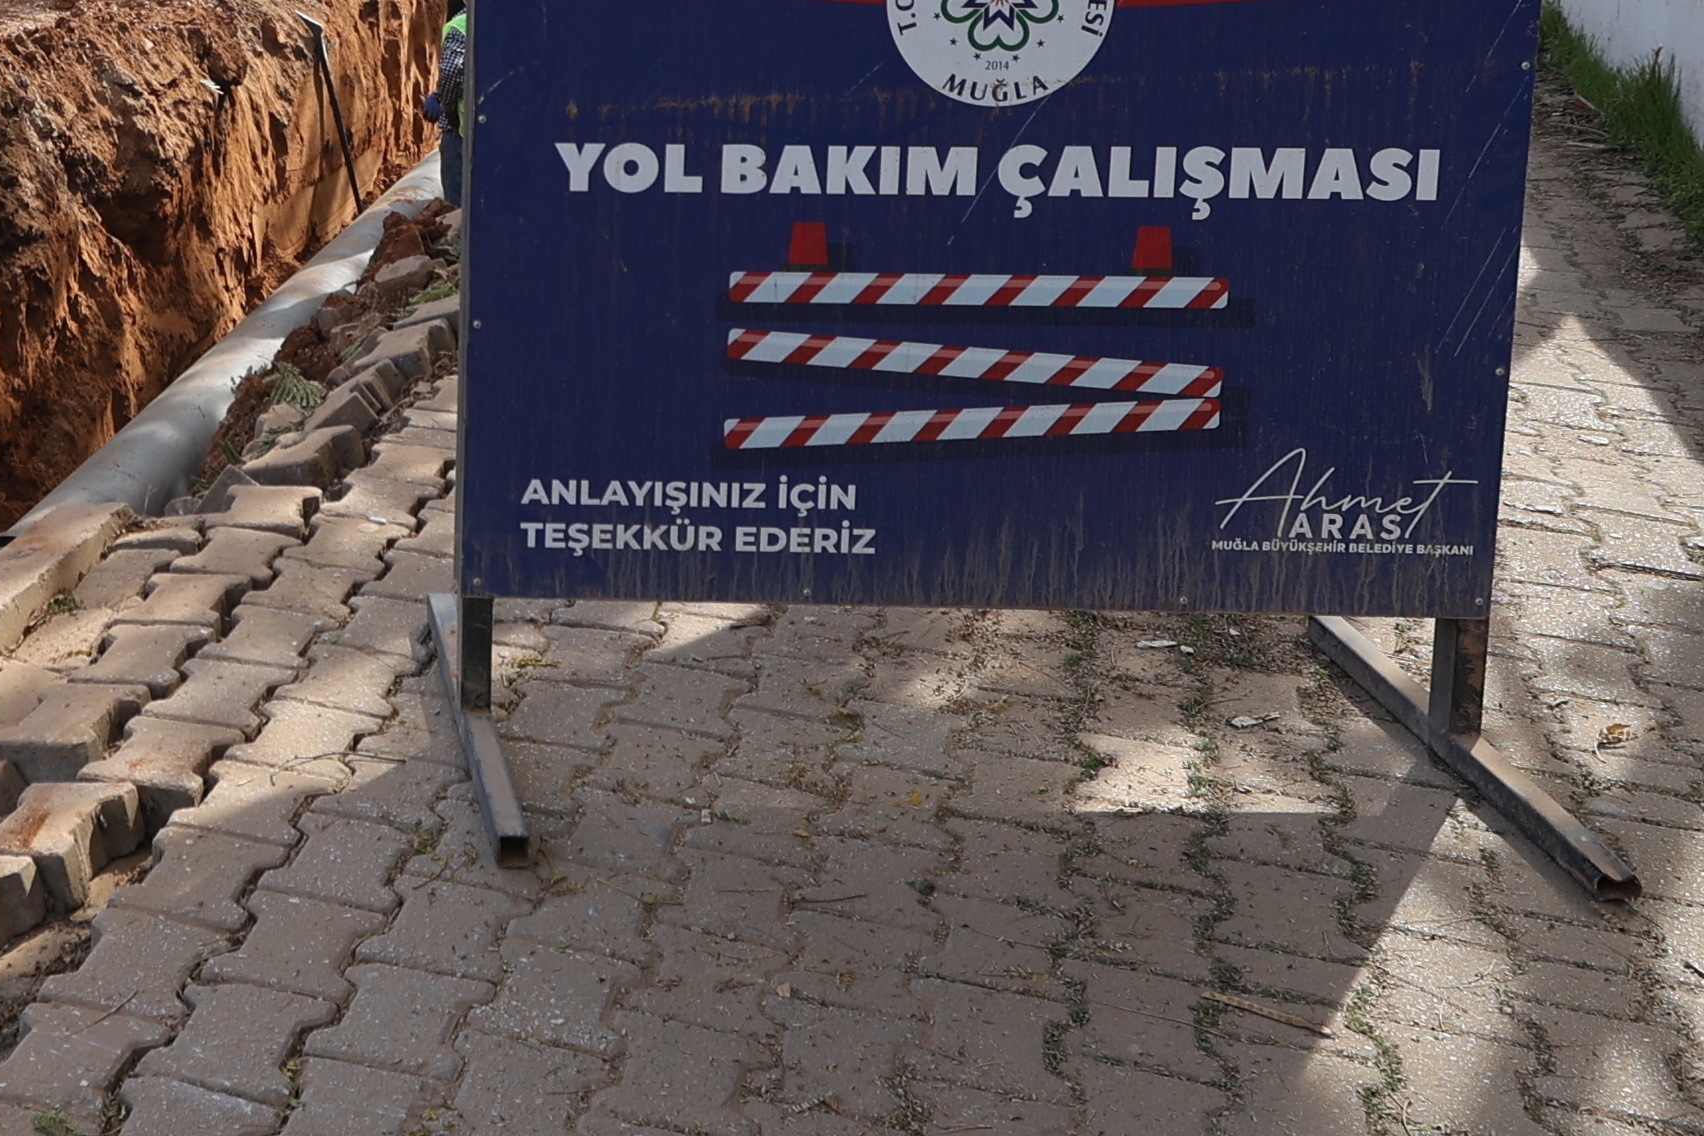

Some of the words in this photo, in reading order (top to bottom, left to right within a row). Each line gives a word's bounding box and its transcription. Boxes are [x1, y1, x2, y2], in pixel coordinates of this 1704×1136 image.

[985, 60, 1010, 71] 2014
[942, 73, 1049, 103] MUĞLA
[555, 142, 703, 196] YOL
[720, 144, 979, 197] BAKIM
[997, 144, 1442, 220] ÇALIŞMASI
[521, 478, 767, 515] ANLAYIŞINIZ
[778, 474, 858, 517] İÇİN
[1215, 447, 1479, 539] Ahmet
[520, 518, 723, 557] TEŞEKKÜR
[734, 520, 877, 555] EDERİZ
[1288, 512, 1403, 541] ARAS
[1211, 537, 1260, 552] MUĞLA
[1261, 539, 1347, 556] BÜYÜKŞEHİR
[1348, 541, 1414, 555] BELEDİYE
[1416, 544, 1474, 558] BAŞKANI
